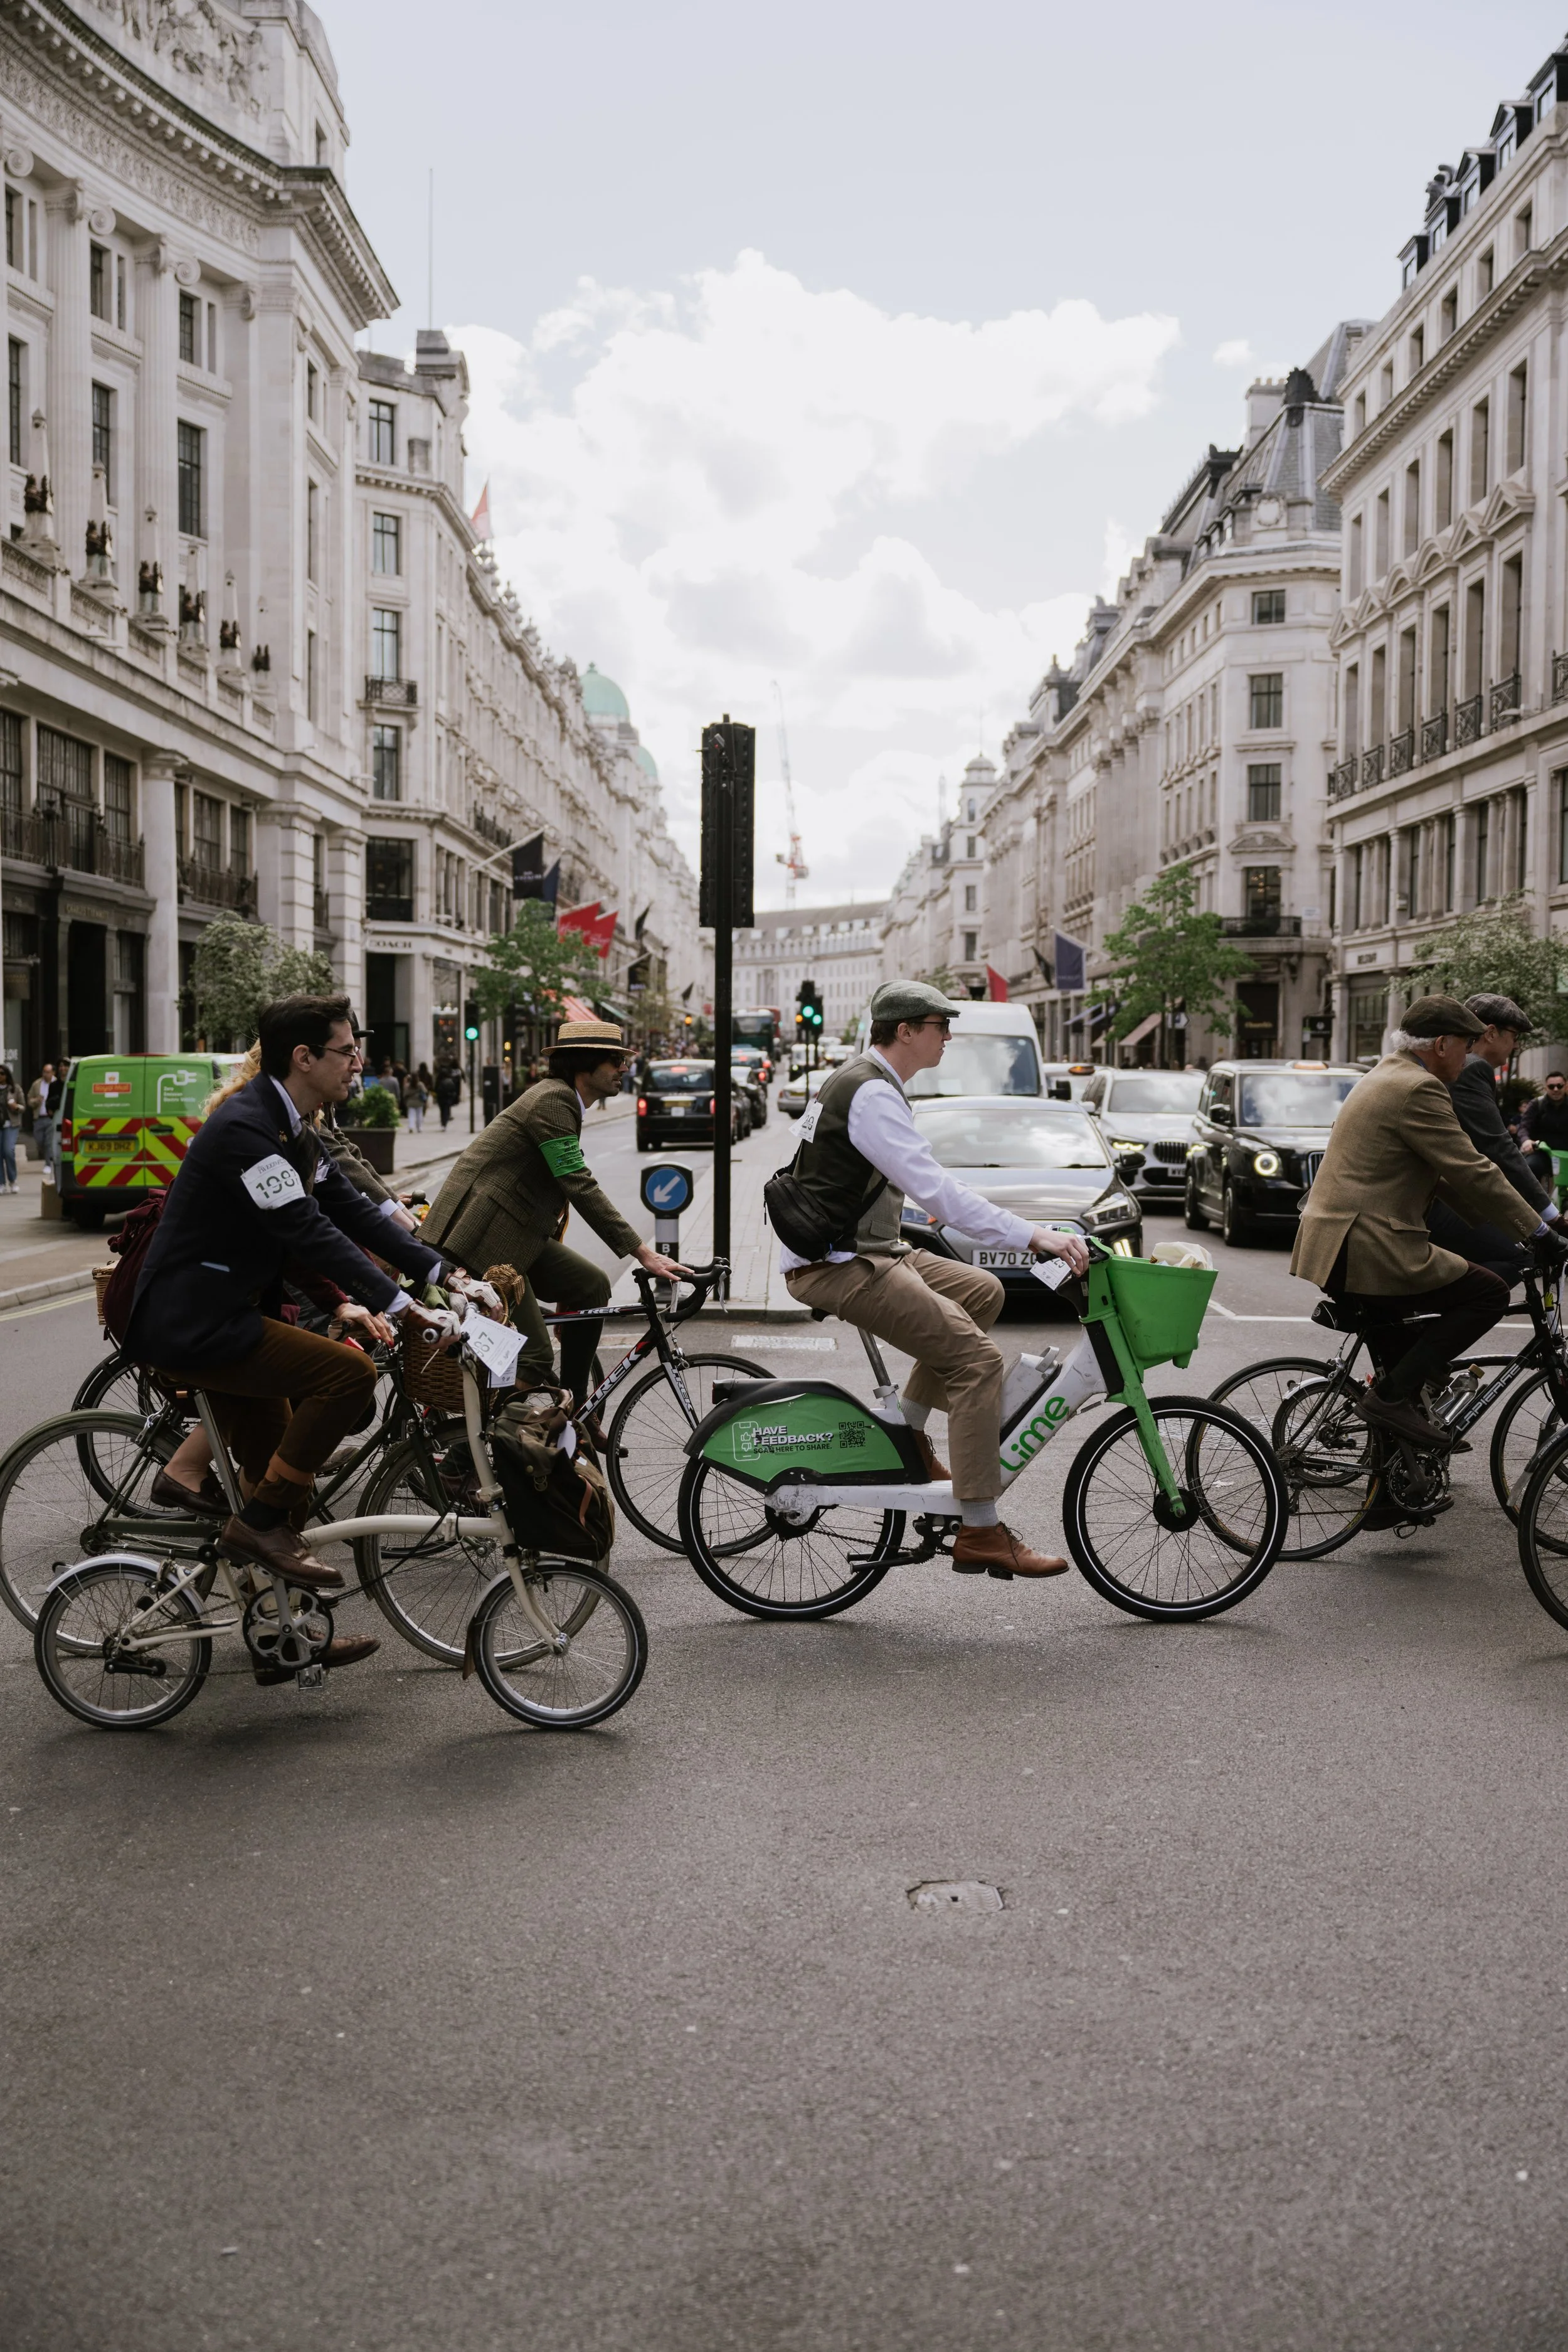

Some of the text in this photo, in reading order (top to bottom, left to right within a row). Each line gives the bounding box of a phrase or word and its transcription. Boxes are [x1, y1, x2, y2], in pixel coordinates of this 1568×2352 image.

[979, 1252, 1017, 1265] BV70
[576, 1347, 642, 1417] TREK
[670, 1366, 694, 1412] TREK
[1456, 1363, 1521, 1431] LAPIERRE
[752, 1425, 788, 1436] HAVE
[753, 1433, 834, 1447] FEEDBACK?
[753, 1446, 775, 1454] SCAN
[807, 1443, 833, 1451] SHARE.
[1326, 1465, 1373, 1475] LAPIERRE
